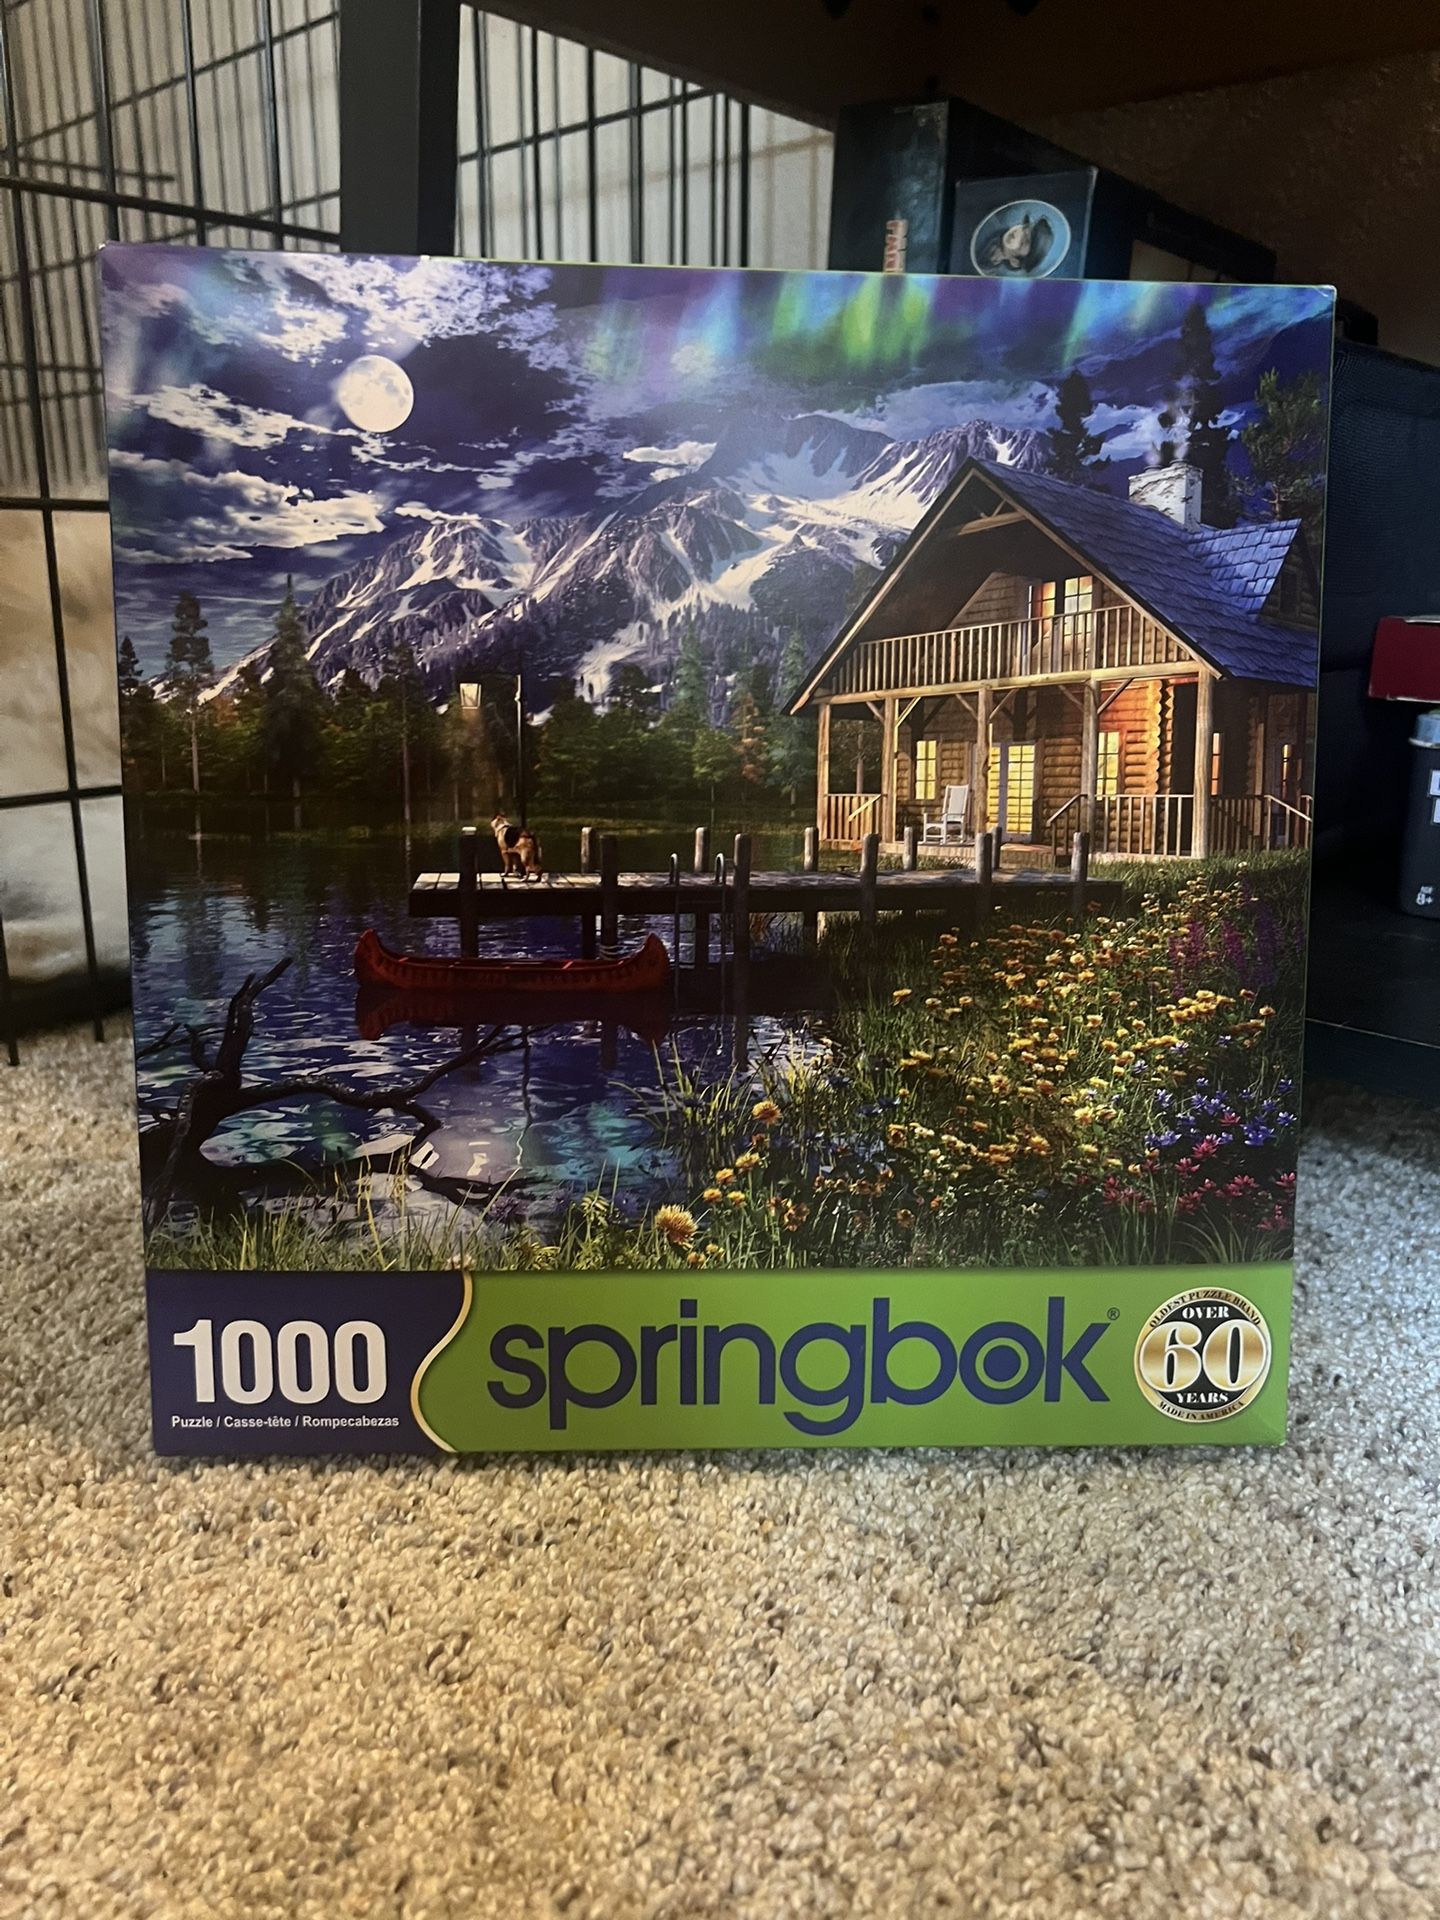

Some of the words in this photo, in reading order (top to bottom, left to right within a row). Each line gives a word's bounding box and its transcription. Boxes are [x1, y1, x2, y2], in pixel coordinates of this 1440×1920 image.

[1149, 1295, 1188, 1328] OLDEST
[1189, 1289, 1233, 1302] PUZZLE
[1233, 1295, 1262, 1327] BRAND
[1181, 1305, 1230, 1319] OVER
[173, 1319, 387, 1405] 1000
[1139, 1319, 1268, 1393] 60
[1176, 1392, 1229, 1405] YEARS
[1158, 1401, 1184, 1419] MADE
[1200, 1400, 1246, 1420] AMERICA
[171, 1415, 213, 1428] Puzzle
[223, 1415, 292, 1429] Casse-tête
[302, 1415, 400, 1429] Rompecabezas
